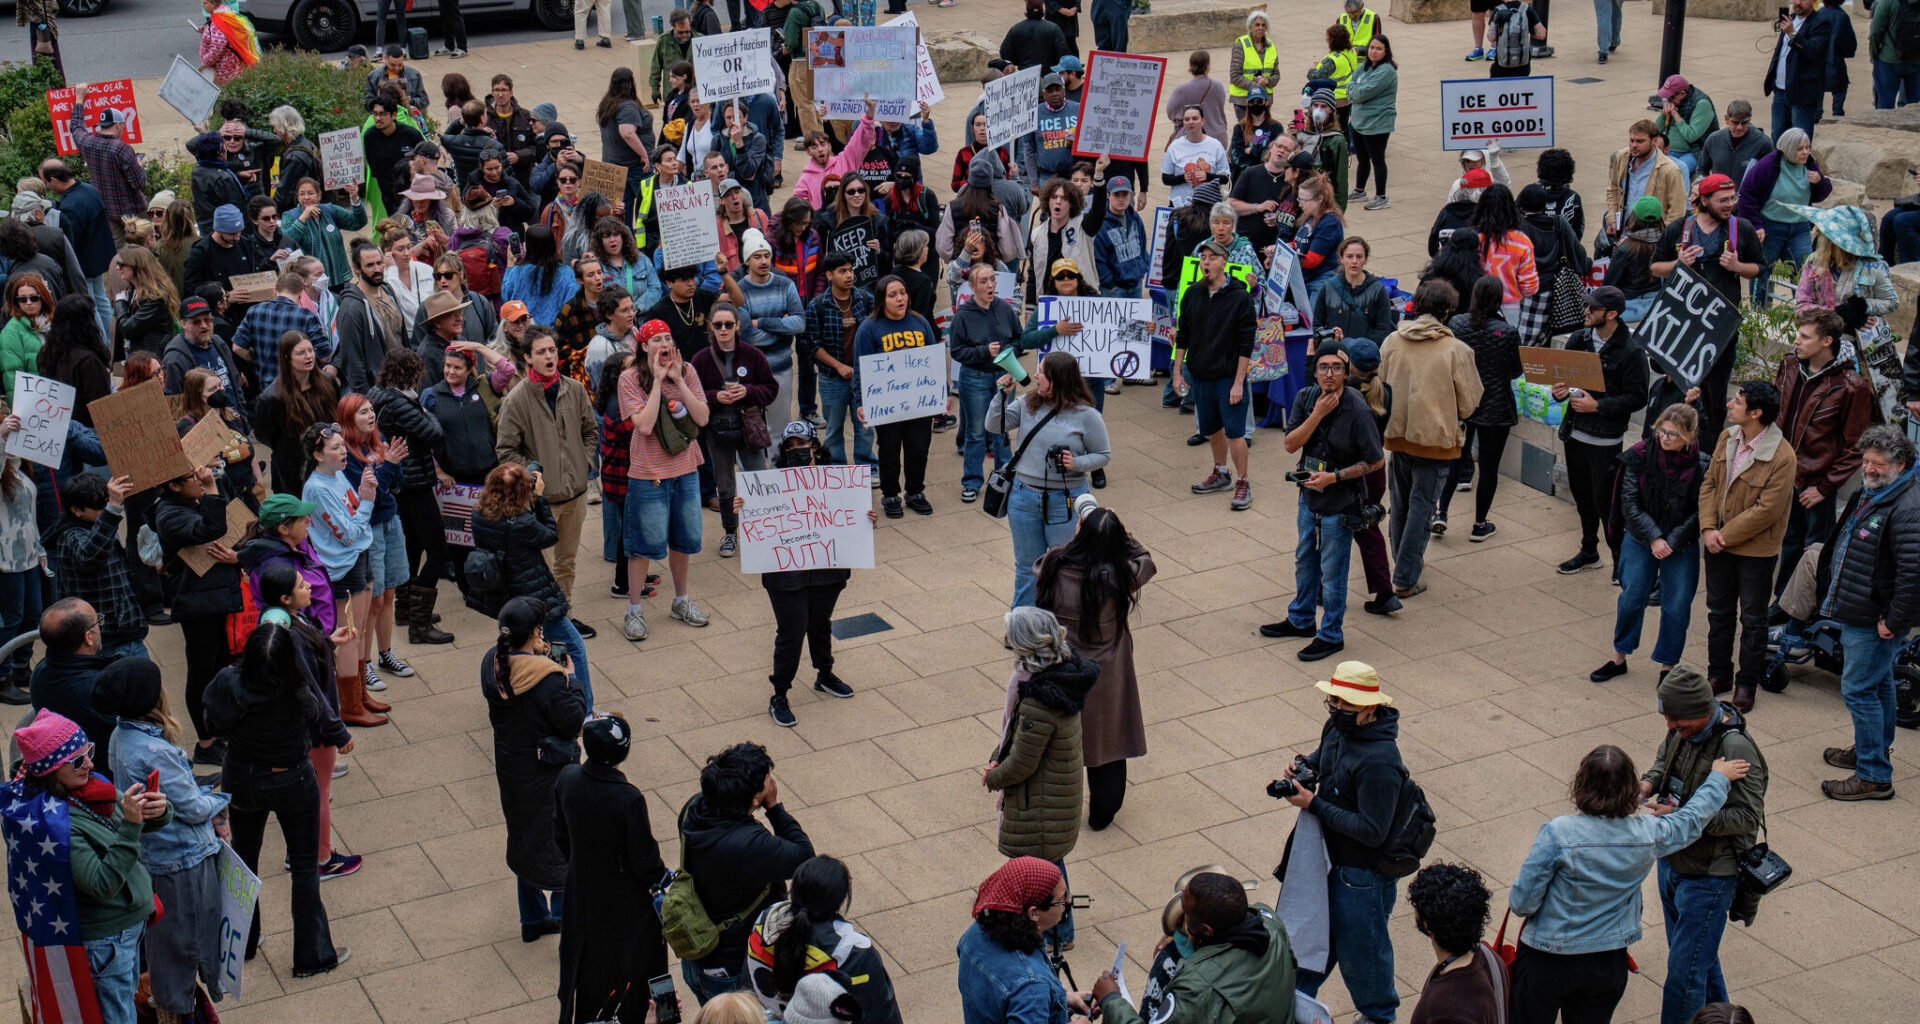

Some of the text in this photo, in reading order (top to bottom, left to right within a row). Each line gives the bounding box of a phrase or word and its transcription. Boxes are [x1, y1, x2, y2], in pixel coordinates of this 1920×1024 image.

[695, 36, 768, 58] You resist fascism
[723, 56, 743, 74] OR
[49, 88, 70, 100] NICE
[702, 75, 770, 98] You assist fascism
[985, 76, 1038, 106] Stop Destroying
[52, 101, 69, 112] ARE
[83, 98, 92, 110] AT
[94, 96, 110, 107] WAR
[830, 102, 862, 115] WARNED
[877, 105, 906, 116] ABOUT
[1460, 92, 1534, 109] ICE OUT
[1011, 111, 1035, 134] Great!
[1040, 115, 1078, 131] ICE IS
[1452, 118, 1544, 136] FOR GOOD!
[1041, 130, 1066, 140] TRUM
[332, 141, 351, 153] APD
[329, 168, 349, 178] NAZI
[656, 184, 695, 200] IS THIS AN
[833, 227, 867, 253] KEEP
[1665, 266, 1727, 331] ICE
[1037, 296, 1140, 327] INHUMANE
[881, 330, 926, 353] UCSB
[1638, 299, 1717, 384] KILLS
[20, 375, 60, 400] ICE
[34, 397, 71, 423] OUT
[27, 414, 51, 432] OF
[14, 425, 61, 458] TEXAS
[741, 464, 872, 498] When INJUSTICE
[741, 491, 829, 520] becomes LAW
[741, 508, 856, 544] RESISTANCE
[779, 531, 821, 547] becomes
[772, 538, 837, 571] DUTY!
[217, 855, 257, 917] ACH
